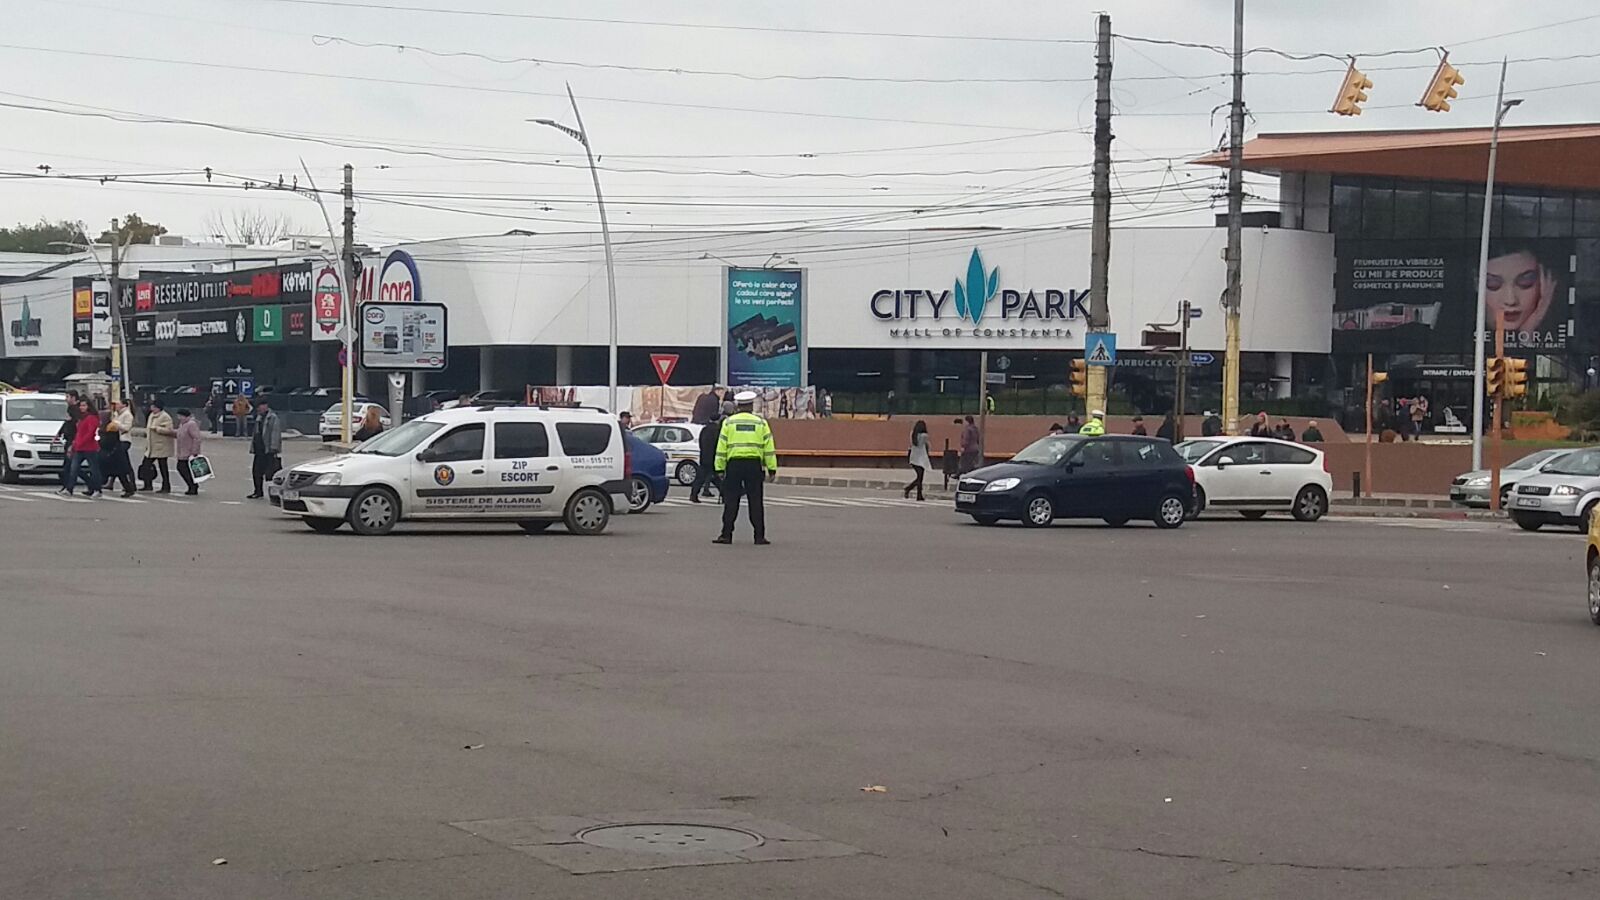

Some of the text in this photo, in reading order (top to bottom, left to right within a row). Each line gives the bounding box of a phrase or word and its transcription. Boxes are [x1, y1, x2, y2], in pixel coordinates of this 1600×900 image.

[1353, 270, 1444, 278] CU MII DE PRODUSE
[155, 281, 200, 304] RESERVED
[381, 280, 412, 301] cora
[870, 289, 1091, 320] CITY PARK
[367, 311, 384, 319] cora
[890, 328, 1072, 337] MALL OF CONSTANTA
[1473, 330, 1554, 342] EHORA
[1115, 359, 1163, 367] ARBUCKS
[511, 460, 528, 470] ZIP
[501, 472, 540, 482] ESCORT
[426, 497, 475, 505] SISTEME
[496, 496, 542, 504] ALARMA
